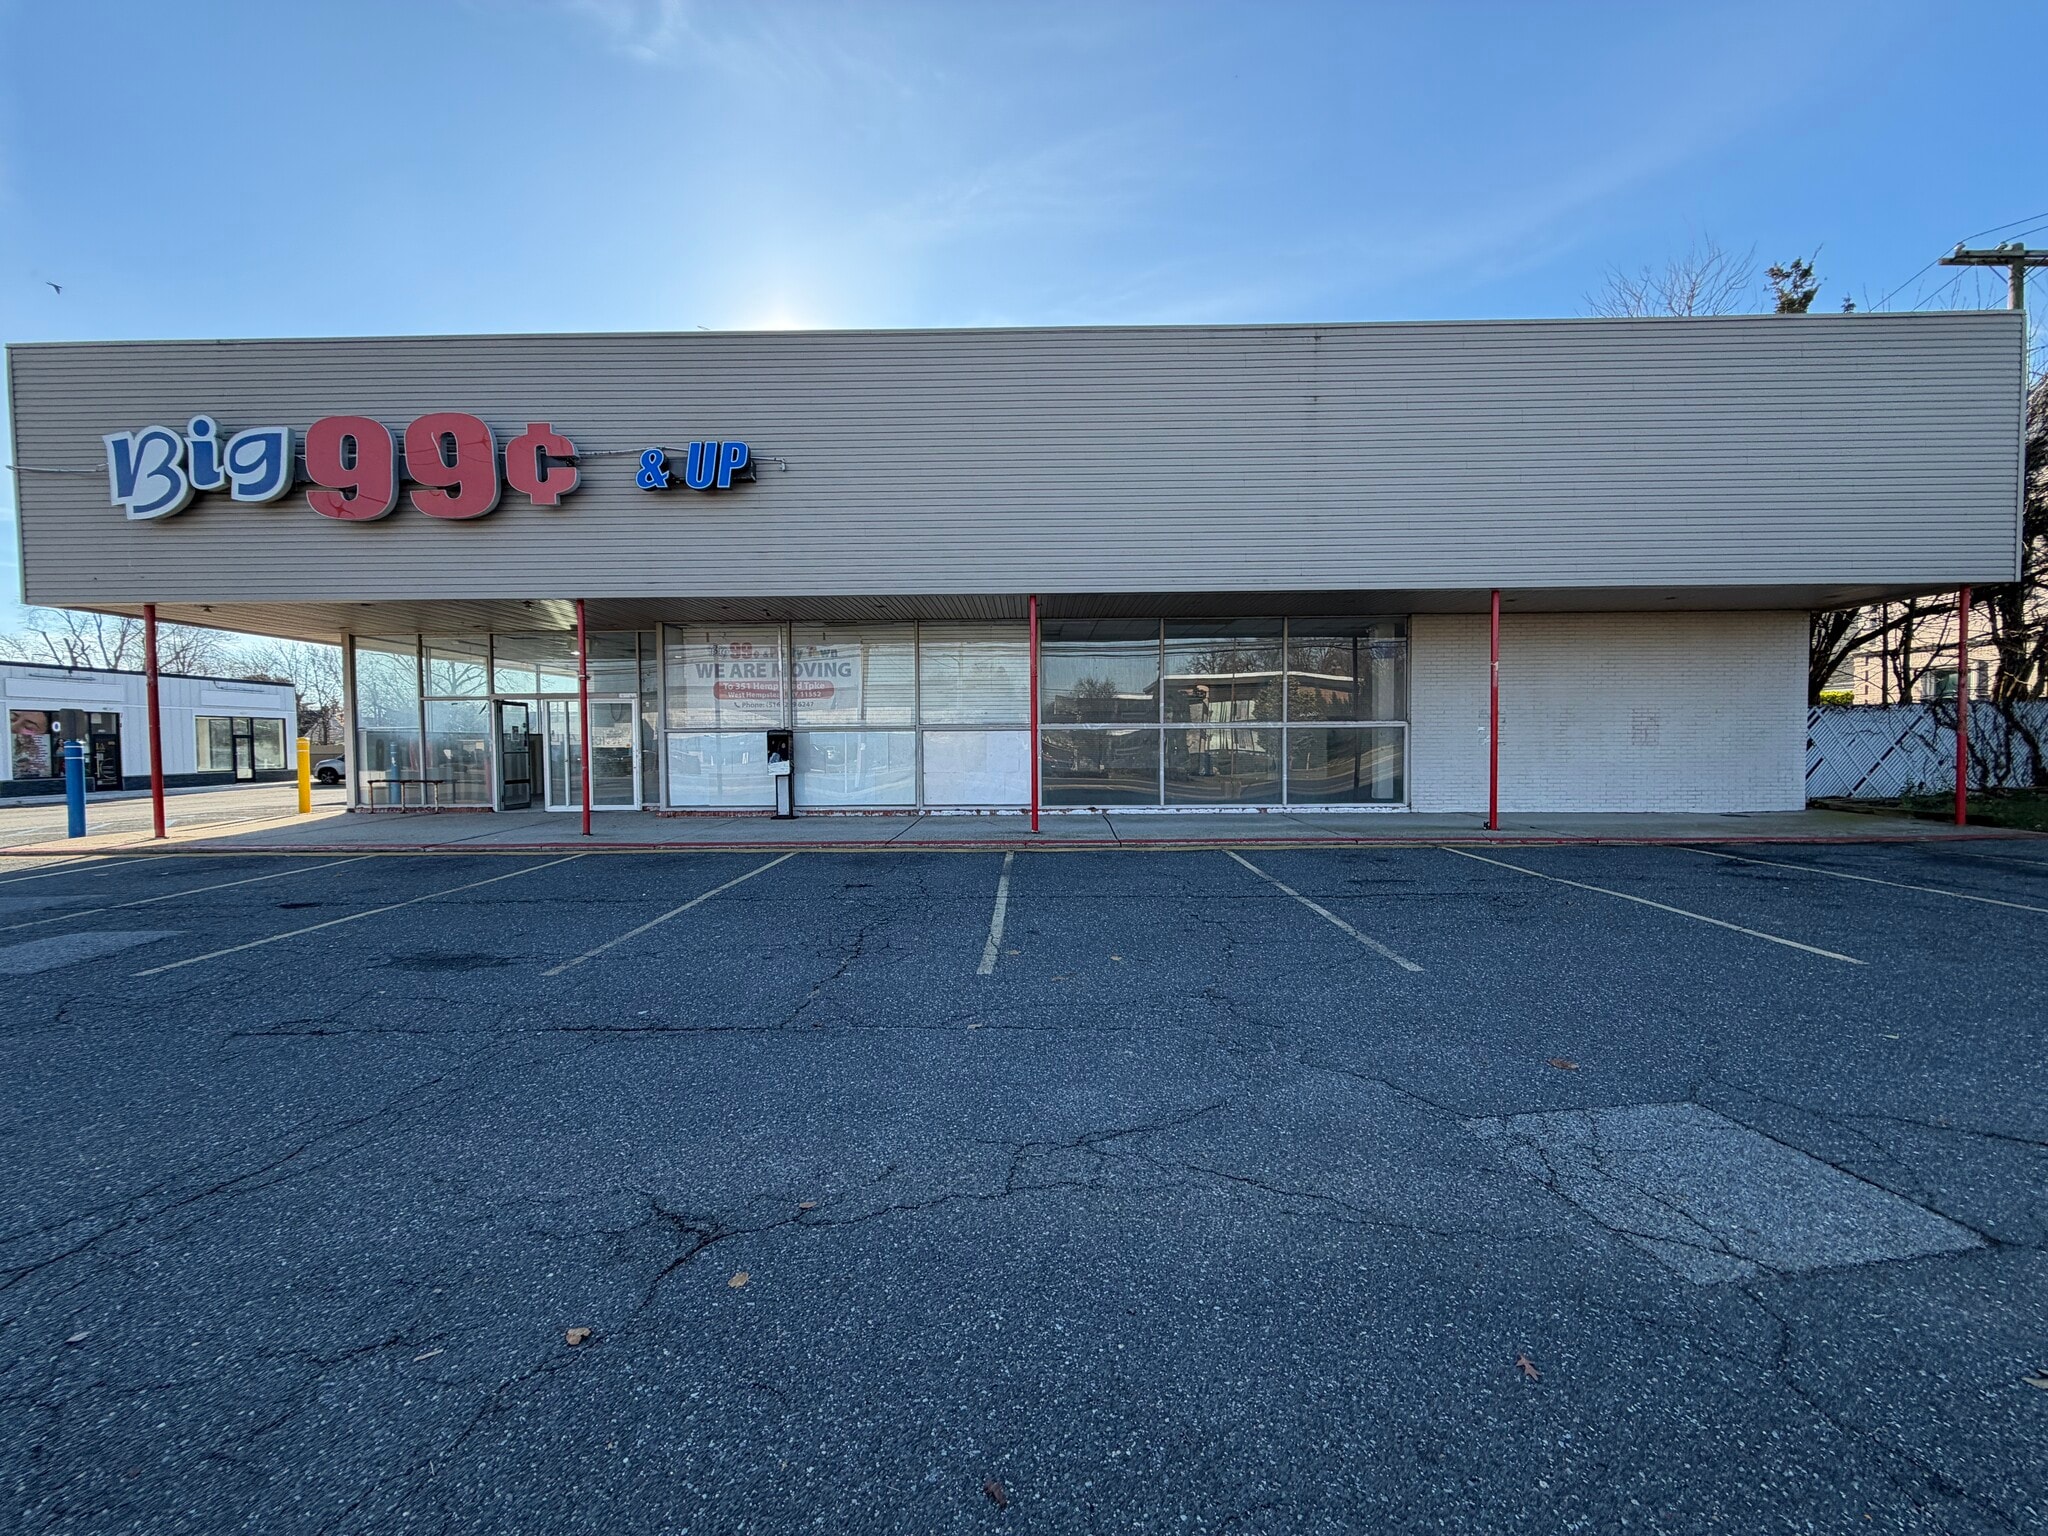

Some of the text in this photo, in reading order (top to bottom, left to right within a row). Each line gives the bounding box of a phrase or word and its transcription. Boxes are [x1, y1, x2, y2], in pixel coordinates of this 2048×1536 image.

[103, 412, 749, 520] Big 99¢ & UP
[696, 662, 851, 678] WE ARE MOVING
[735, 682, 750, 690] 351
[804, 682, 825, 691] Tpke
